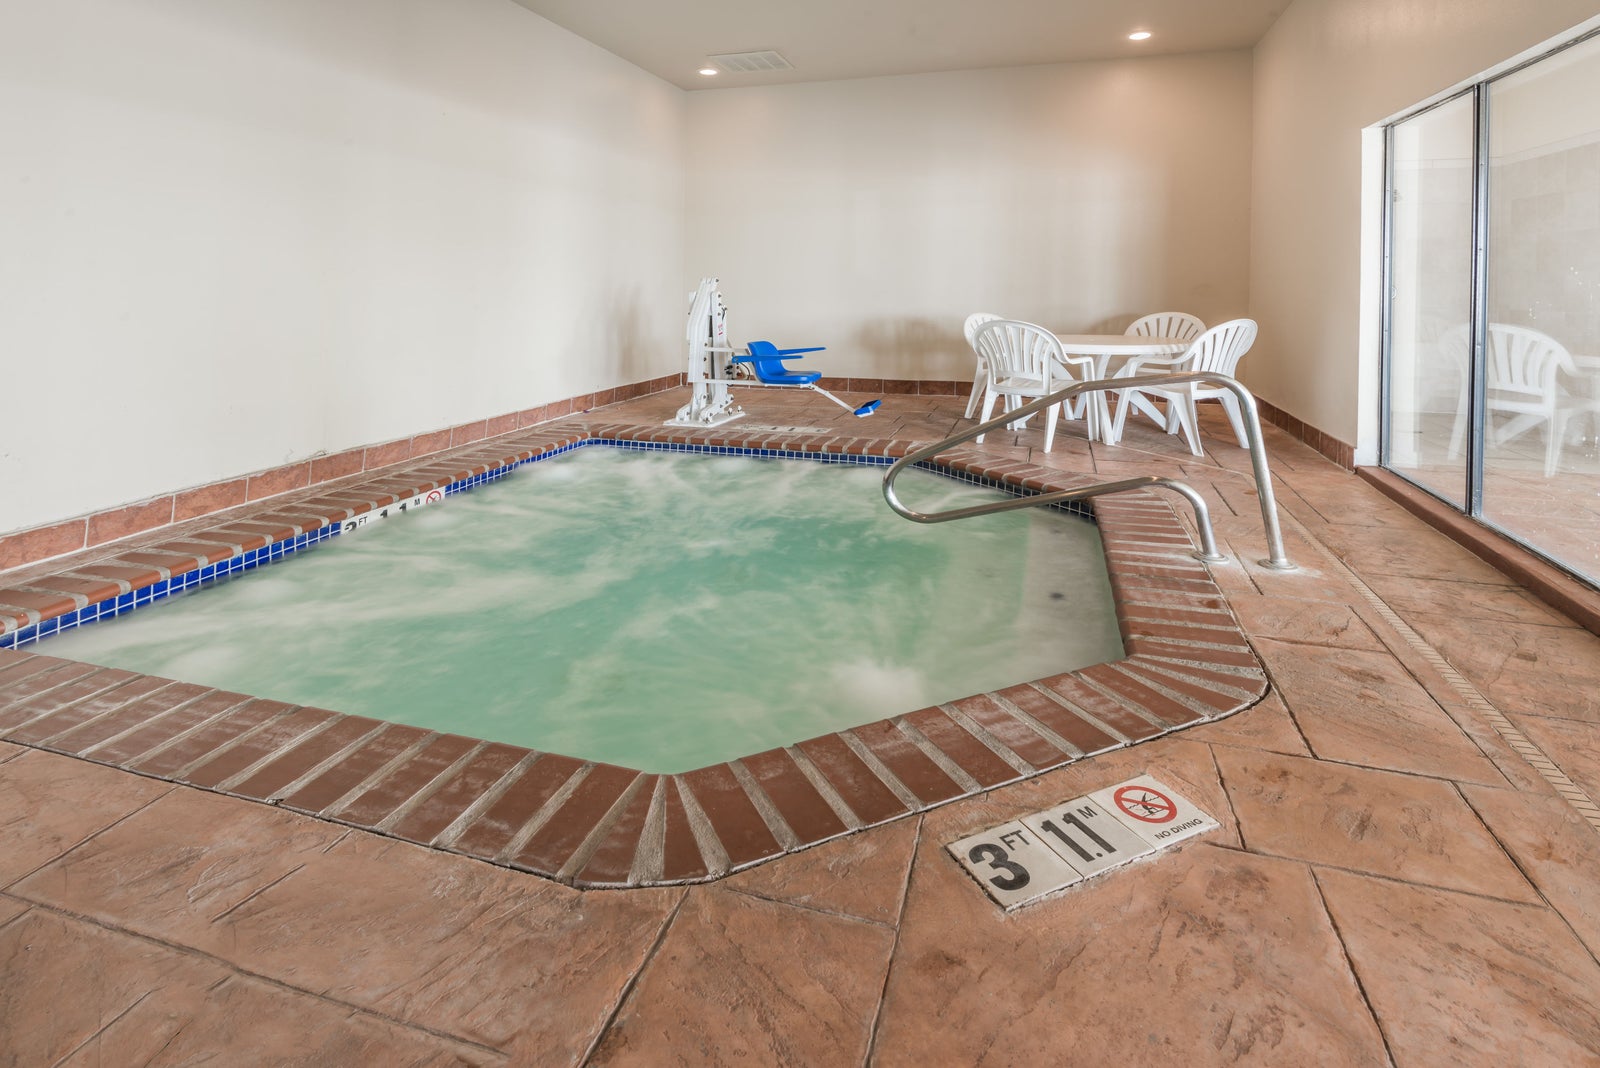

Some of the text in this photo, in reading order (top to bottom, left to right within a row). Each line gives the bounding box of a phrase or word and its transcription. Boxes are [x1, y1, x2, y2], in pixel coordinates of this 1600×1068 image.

[358, 516, 368, 526] FT
[414, 498, 421, 506] M
[1076, 805, 1098, 819] M
[999, 829, 1030, 851] FT
[1154, 818, 1203, 840] NO DIVING
[968, 843, 1031, 891] 3
